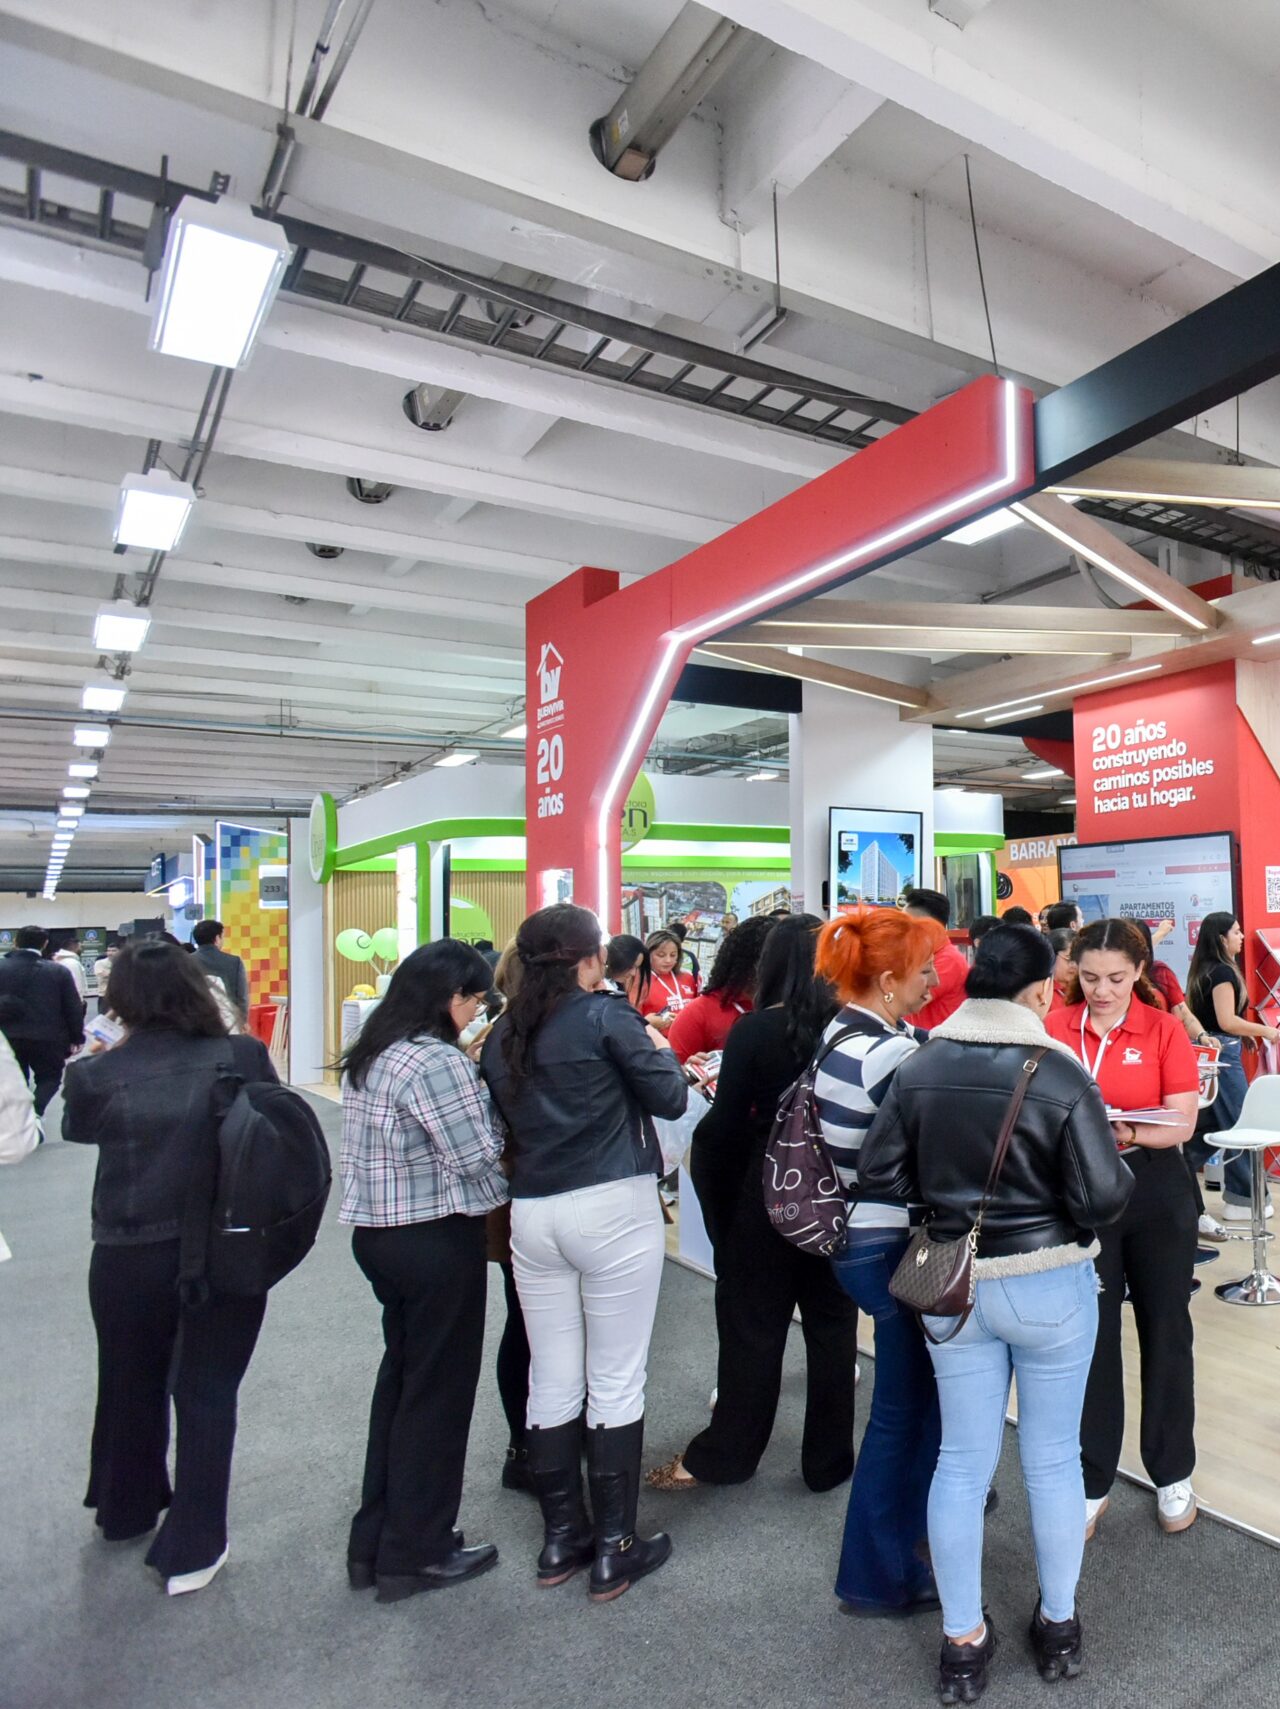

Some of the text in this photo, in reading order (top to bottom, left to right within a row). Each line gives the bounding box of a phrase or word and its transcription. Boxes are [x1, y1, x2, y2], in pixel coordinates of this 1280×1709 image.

[1092, 718, 1167, 753] 20 años
[537, 734, 564, 785] 20
[1092, 738, 1188, 771] construyendo
[1093, 757, 1214, 793] caminos posibles
[537, 787, 565, 819] años
[1094, 786, 1197, 814] hacia tu hogar.
[263, 885, 281, 893] 233
[1120, 902, 1175, 911] APARTAMENTOS
[1135, 910, 1176, 919] ACABADOS
